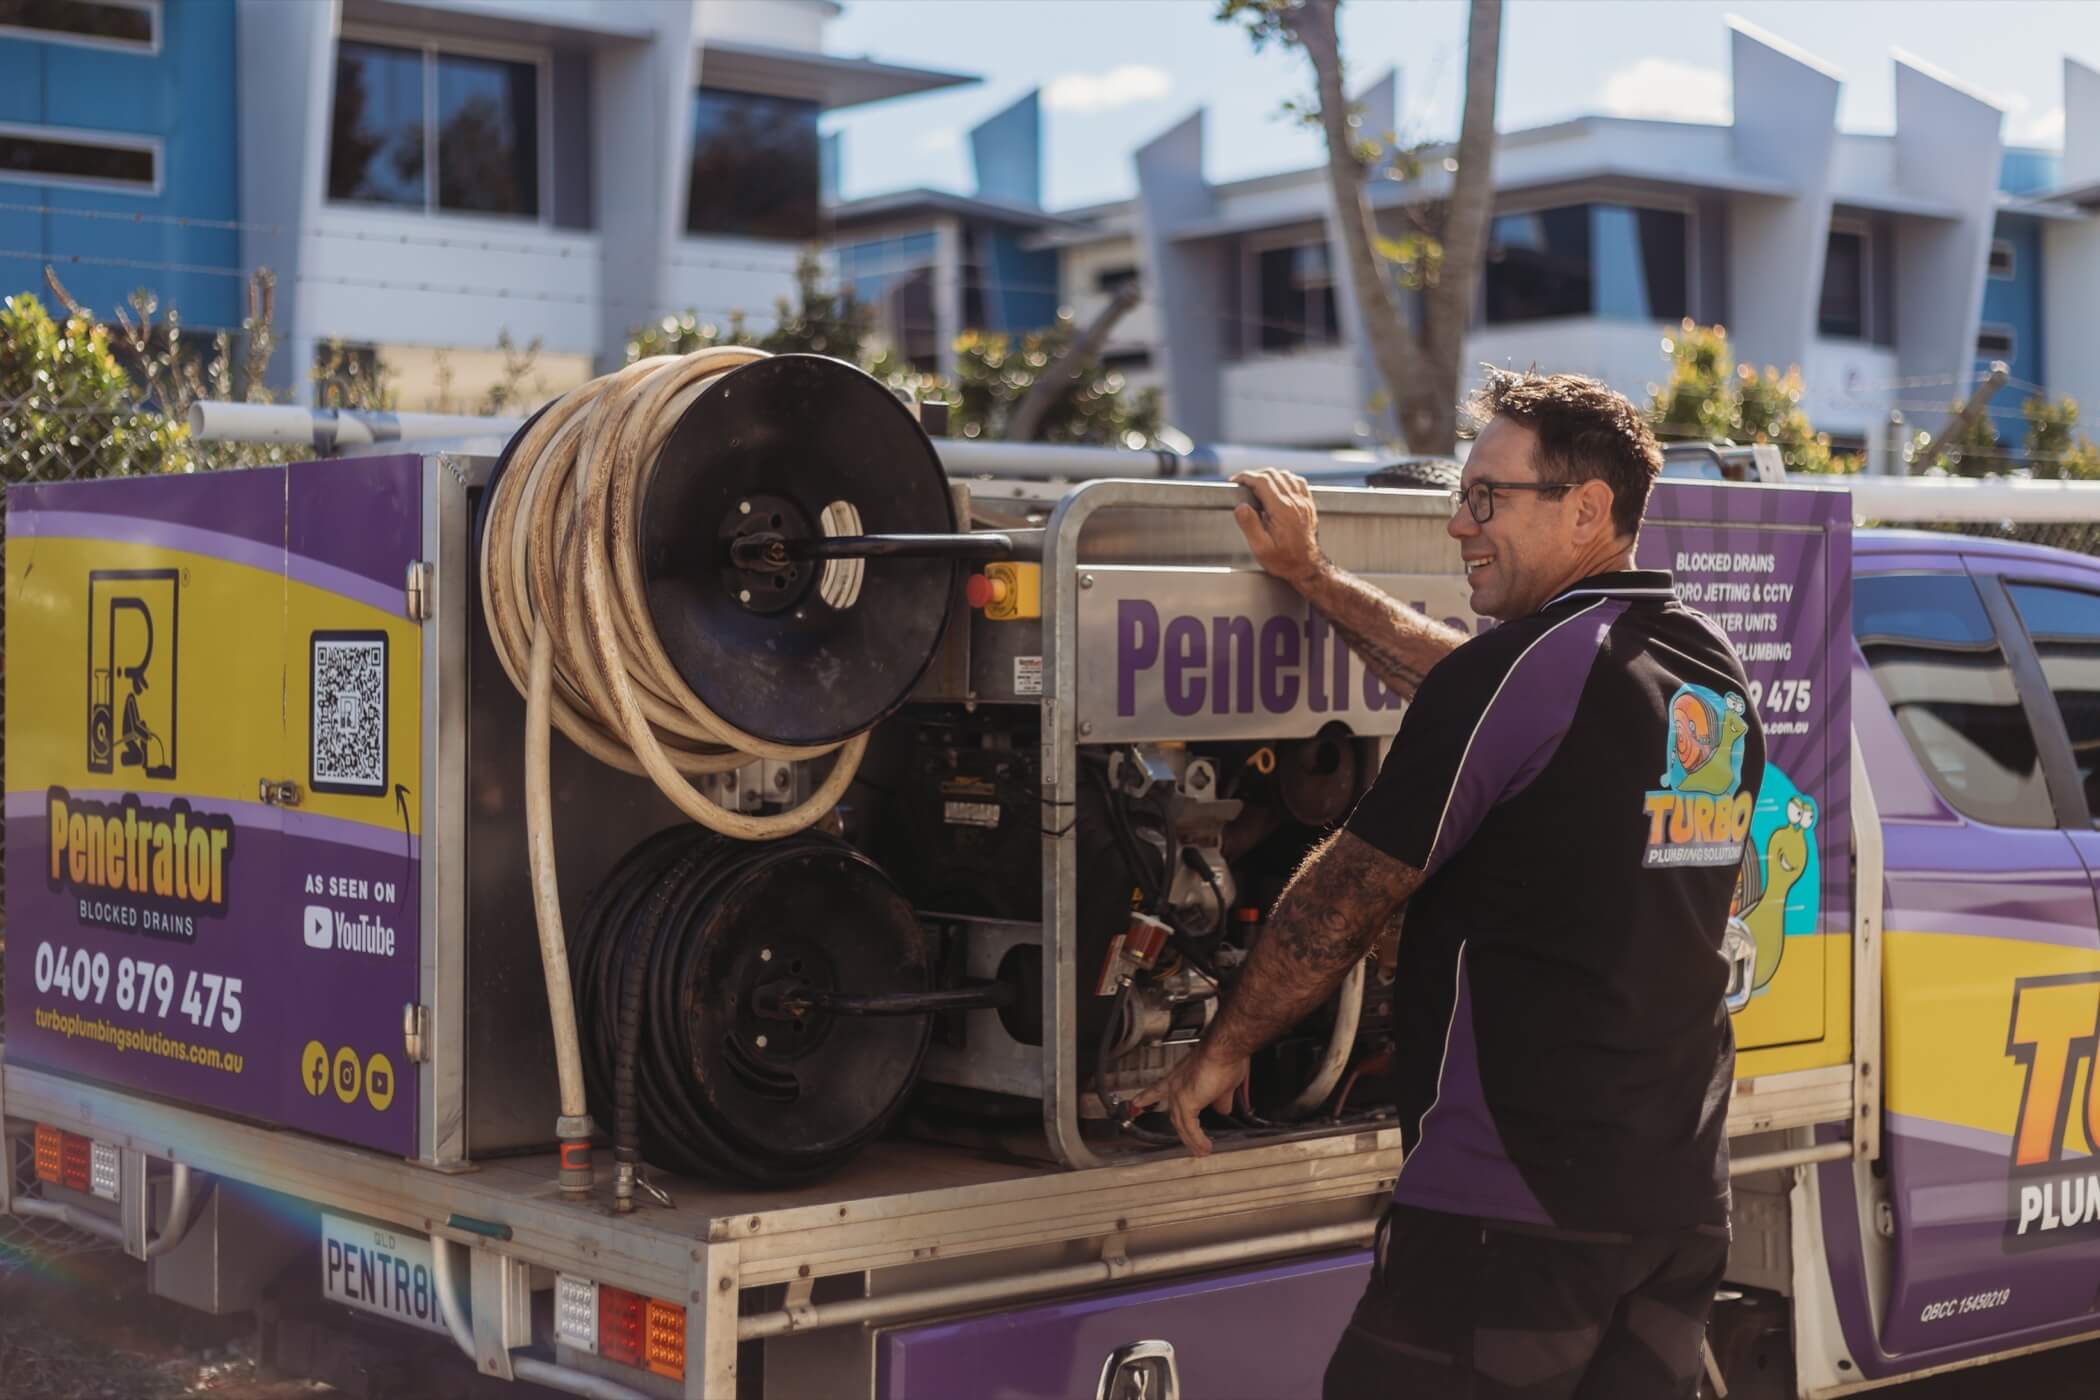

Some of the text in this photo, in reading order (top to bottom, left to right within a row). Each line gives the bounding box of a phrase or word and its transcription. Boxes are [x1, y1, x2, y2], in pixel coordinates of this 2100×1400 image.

[1676, 553, 1775, 573] BLOCKED DRAINS
[1704, 583, 1751, 602] JETTING
[1752, 584, 1762, 602] &
[1763, 585, 1793, 603] CCTV
[1744, 613, 1777, 633] UNITS
[1735, 642, 1792, 662] PLUMBING
[1766, 680, 1811, 713] 475
[1647, 791, 1752, 845] TURBO
[51, 800, 229, 903] Penetrator
[305, 874, 396, 903] AS SEEN ON
[80, 900, 193, 936] BLOCKED DRAINS
[334, 911, 395, 957] YouTube
[35, 942, 243, 1033] 0409 879 475
[35, 1008, 243, 1074] turboplumbingsolutions.com.au
[1921, 1299, 1958, 1323] QBCC
